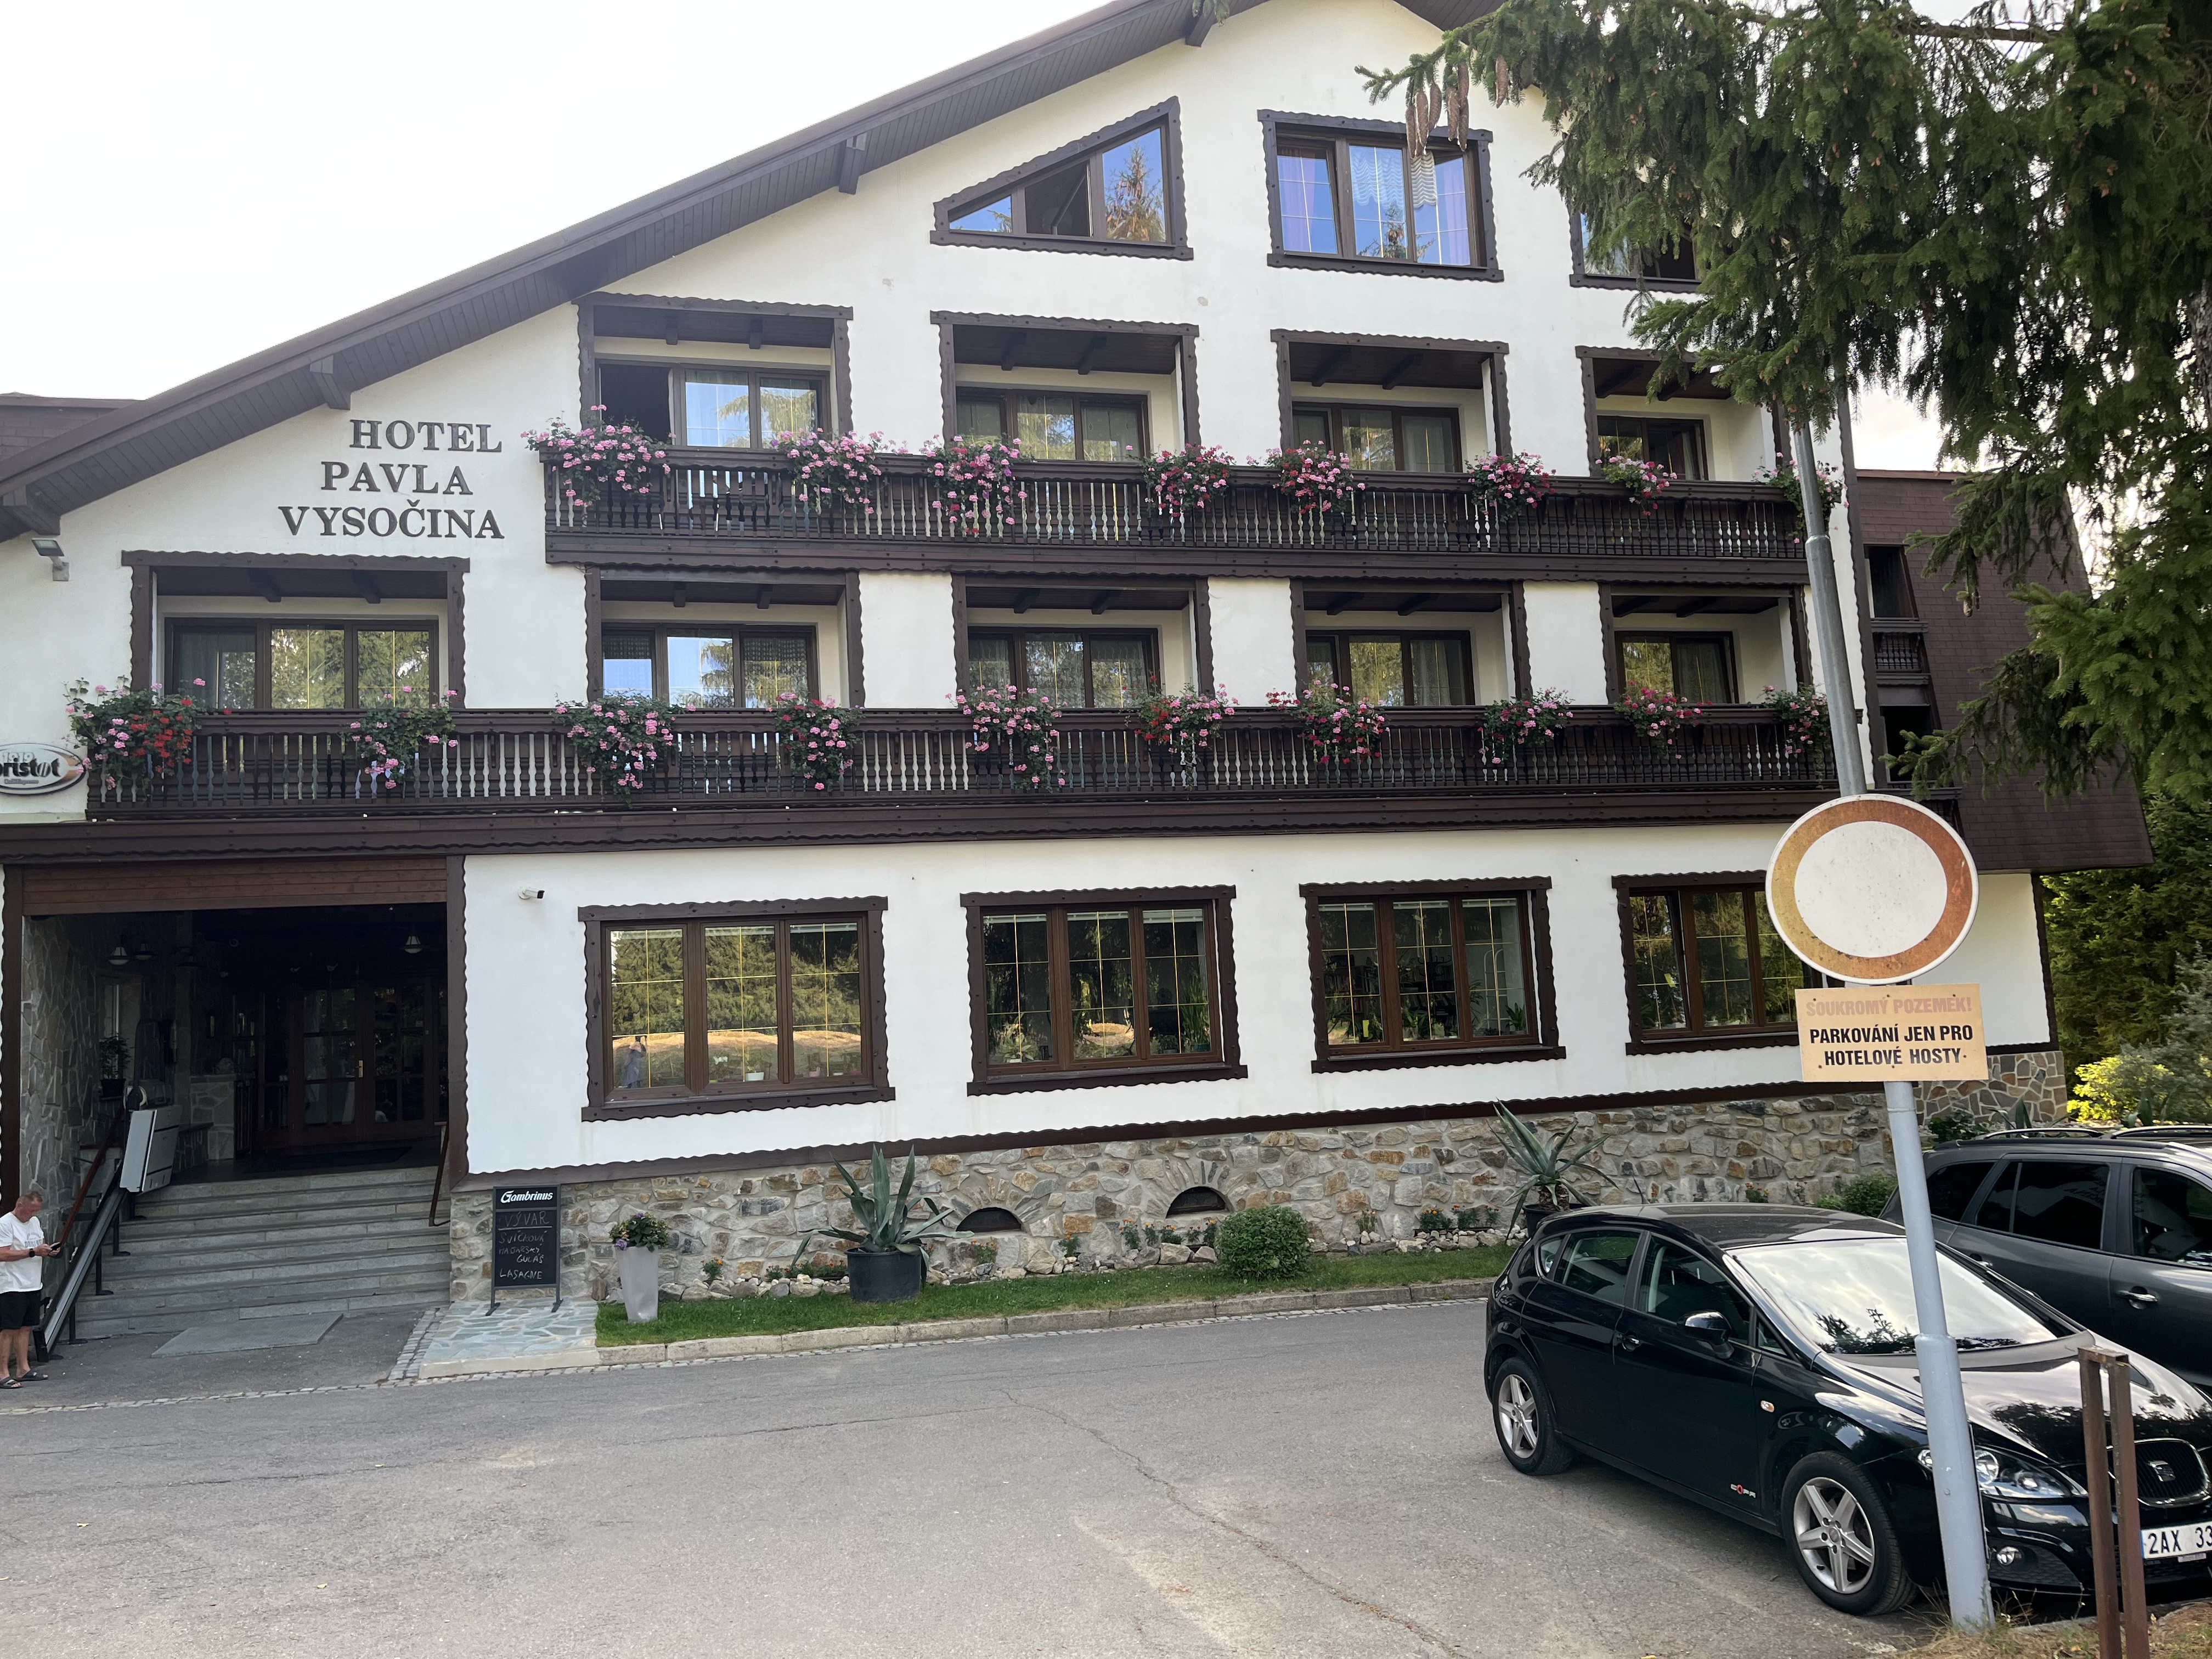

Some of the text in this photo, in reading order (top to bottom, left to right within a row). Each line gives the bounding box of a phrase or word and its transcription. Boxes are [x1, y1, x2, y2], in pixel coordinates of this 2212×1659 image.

[349, 419, 502, 453] HOTEL
[321, 461, 473, 495] PAVLA
[278, 499, 505, 539] VYSOČINA
[3, 752, 35, 763] 1919
[1806, 997, 1972, 1016] SOUKROMÝ POZEMEK!
[1810, 1024, 1973, 1043] PARKOVÁNÍ JEN PRO
[1825, 1046, 1961, 1065] HOTELOVÉ HOSTY
[500, 1190, 554, 1204] Gambrinus
[505, 1211, 549, 1227] VÝVAR
[500, 1268, 543, 1280] LASAGNE
[2148, 1530, 2182, 1554] 2AX
